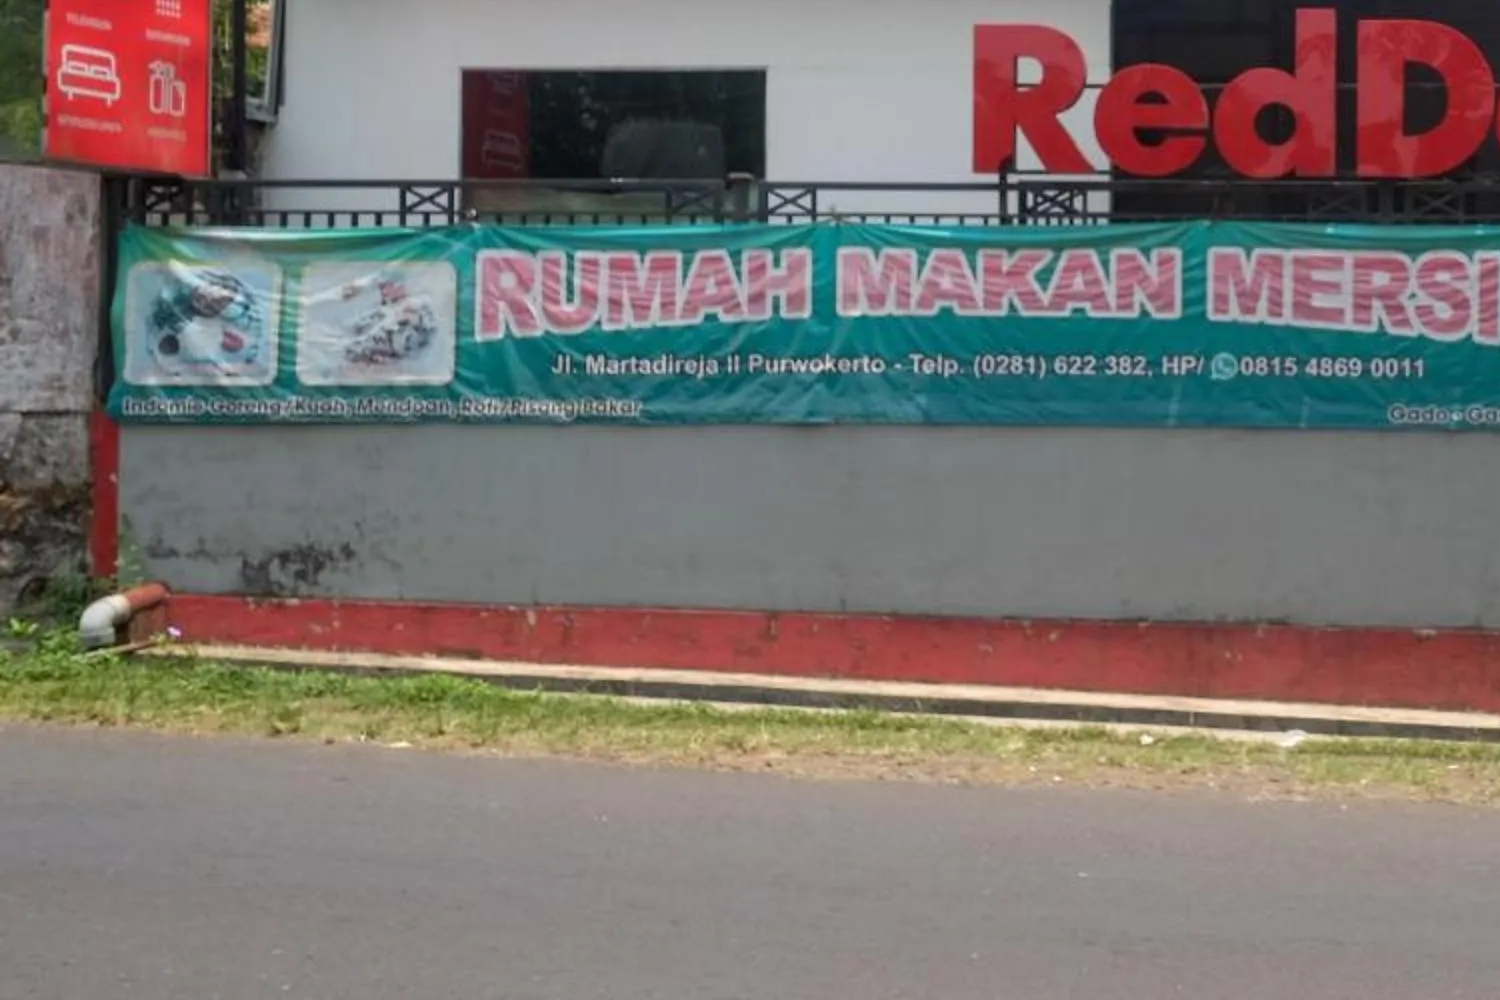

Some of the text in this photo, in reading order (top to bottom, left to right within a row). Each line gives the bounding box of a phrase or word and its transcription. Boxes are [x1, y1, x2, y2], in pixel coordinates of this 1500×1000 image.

[474, 248, 813, 341] RUMAH
[835, 246, 1182, 319] MAKAN
[551, 354, 577, 375] Jl.
[585, 353, 719, 379] Martadireja
[748, 353, 886, 375] Purwokerto
[908, 353, 964, 379] Telp.
[973, 353, 1047, 379] (0281)
[1053, 354, 1096, 376] 622
[1105, 354, 1153, 378] 382,
[1161, 355, 1204, 375] HP/
[1240, 356, 1298, 376] 0815
[1305, 357, 1362, 377] 4869
[1370, 358, 1425, 378] 0011
